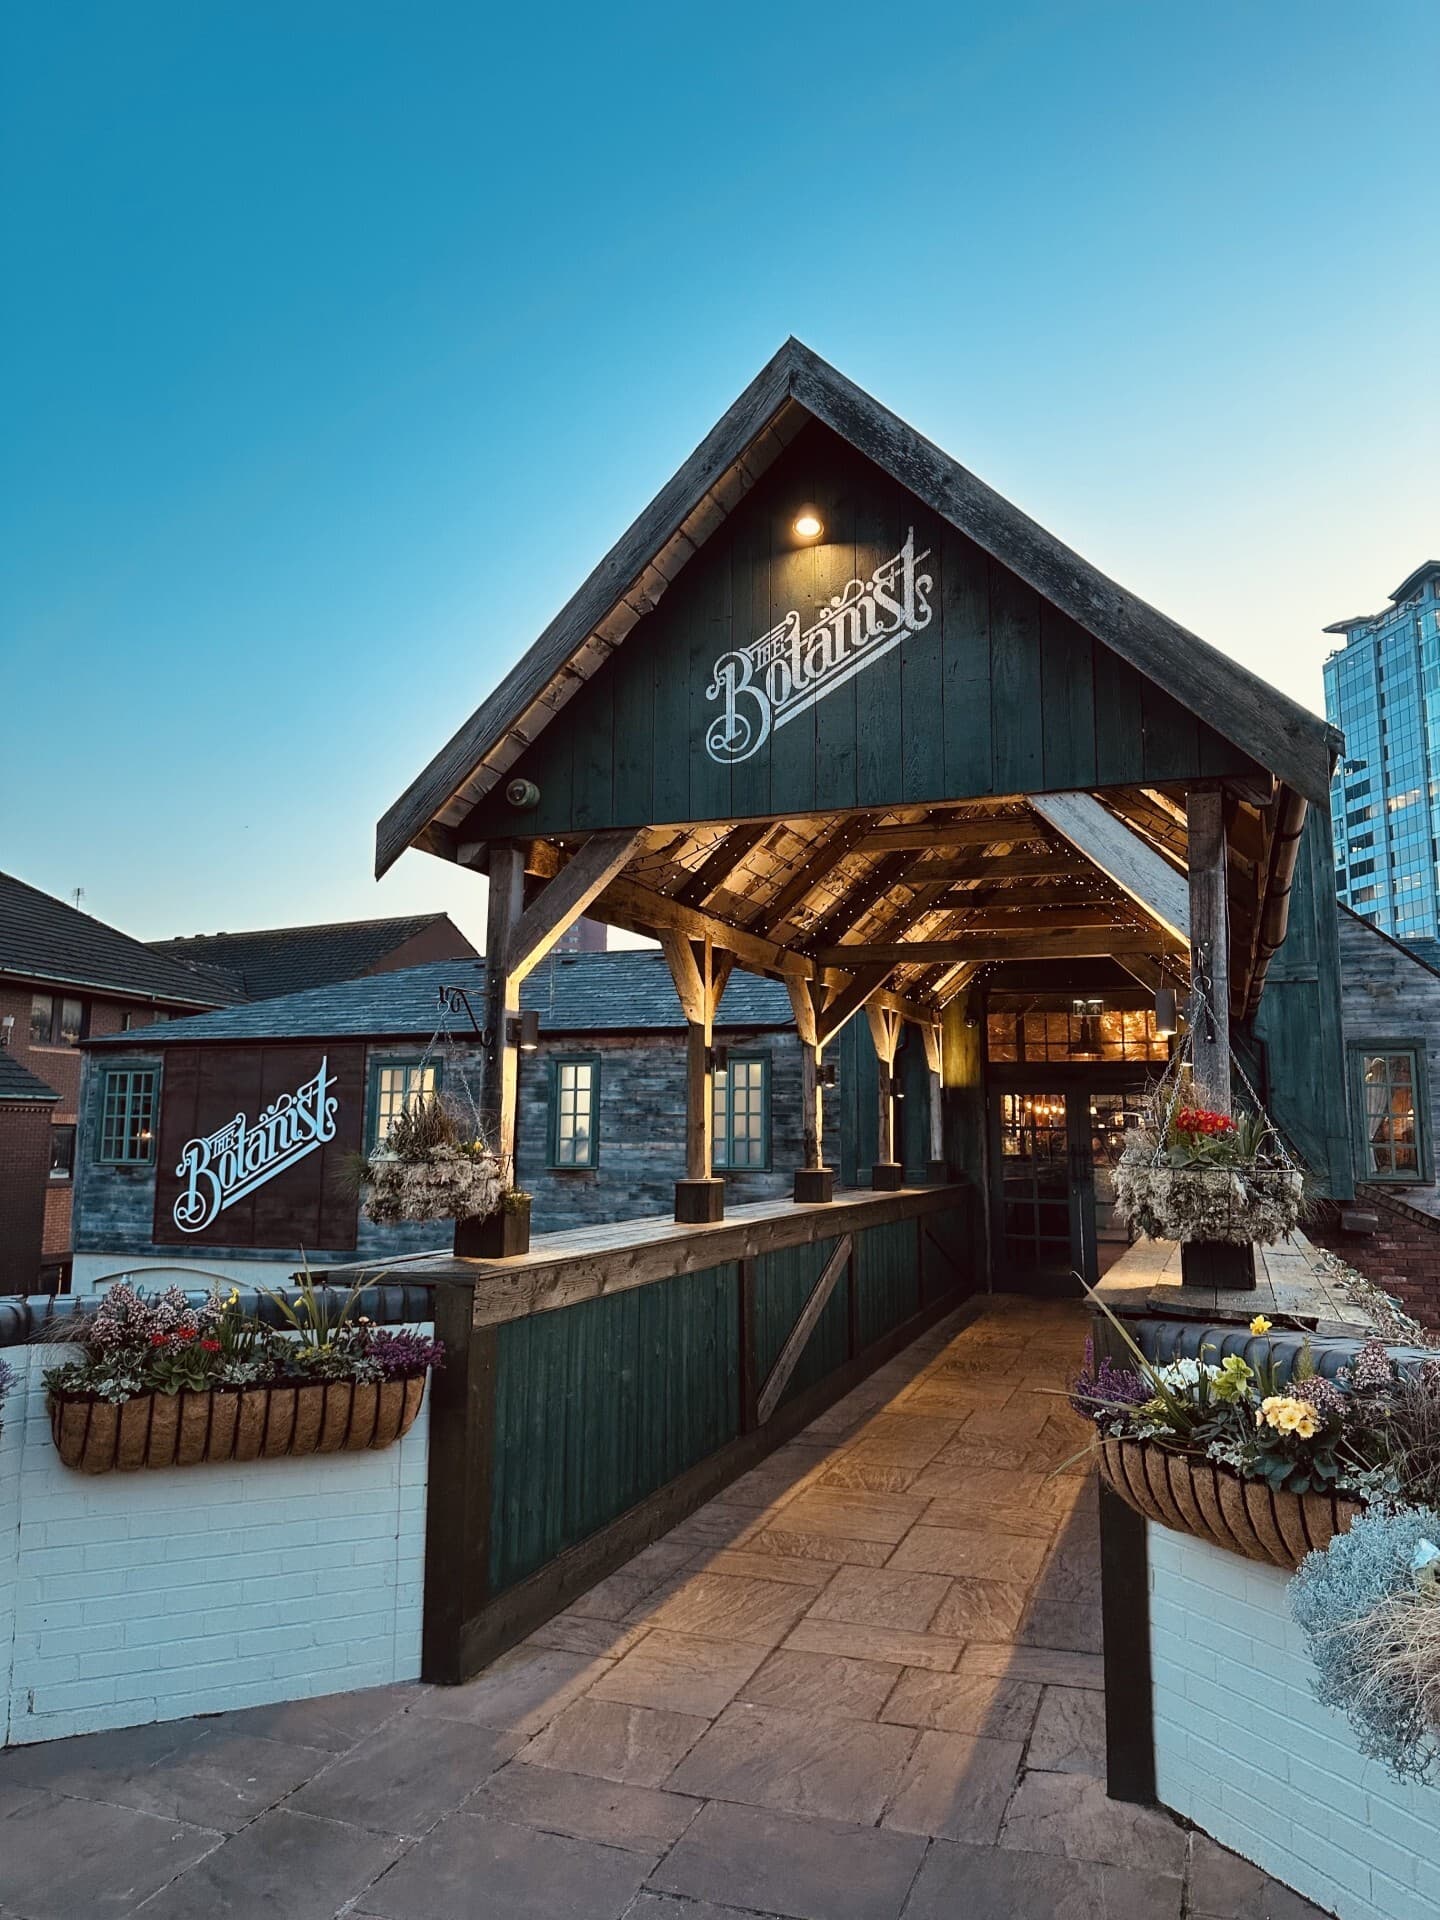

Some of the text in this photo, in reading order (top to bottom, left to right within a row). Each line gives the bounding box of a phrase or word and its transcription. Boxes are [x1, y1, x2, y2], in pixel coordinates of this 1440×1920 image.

[705, 526, 933, 763] Botanist
[750, 632, 786, 672] THE
[173, 1055, 338, 1232] Botanist
[210, 1129, 236, 1159] THE
